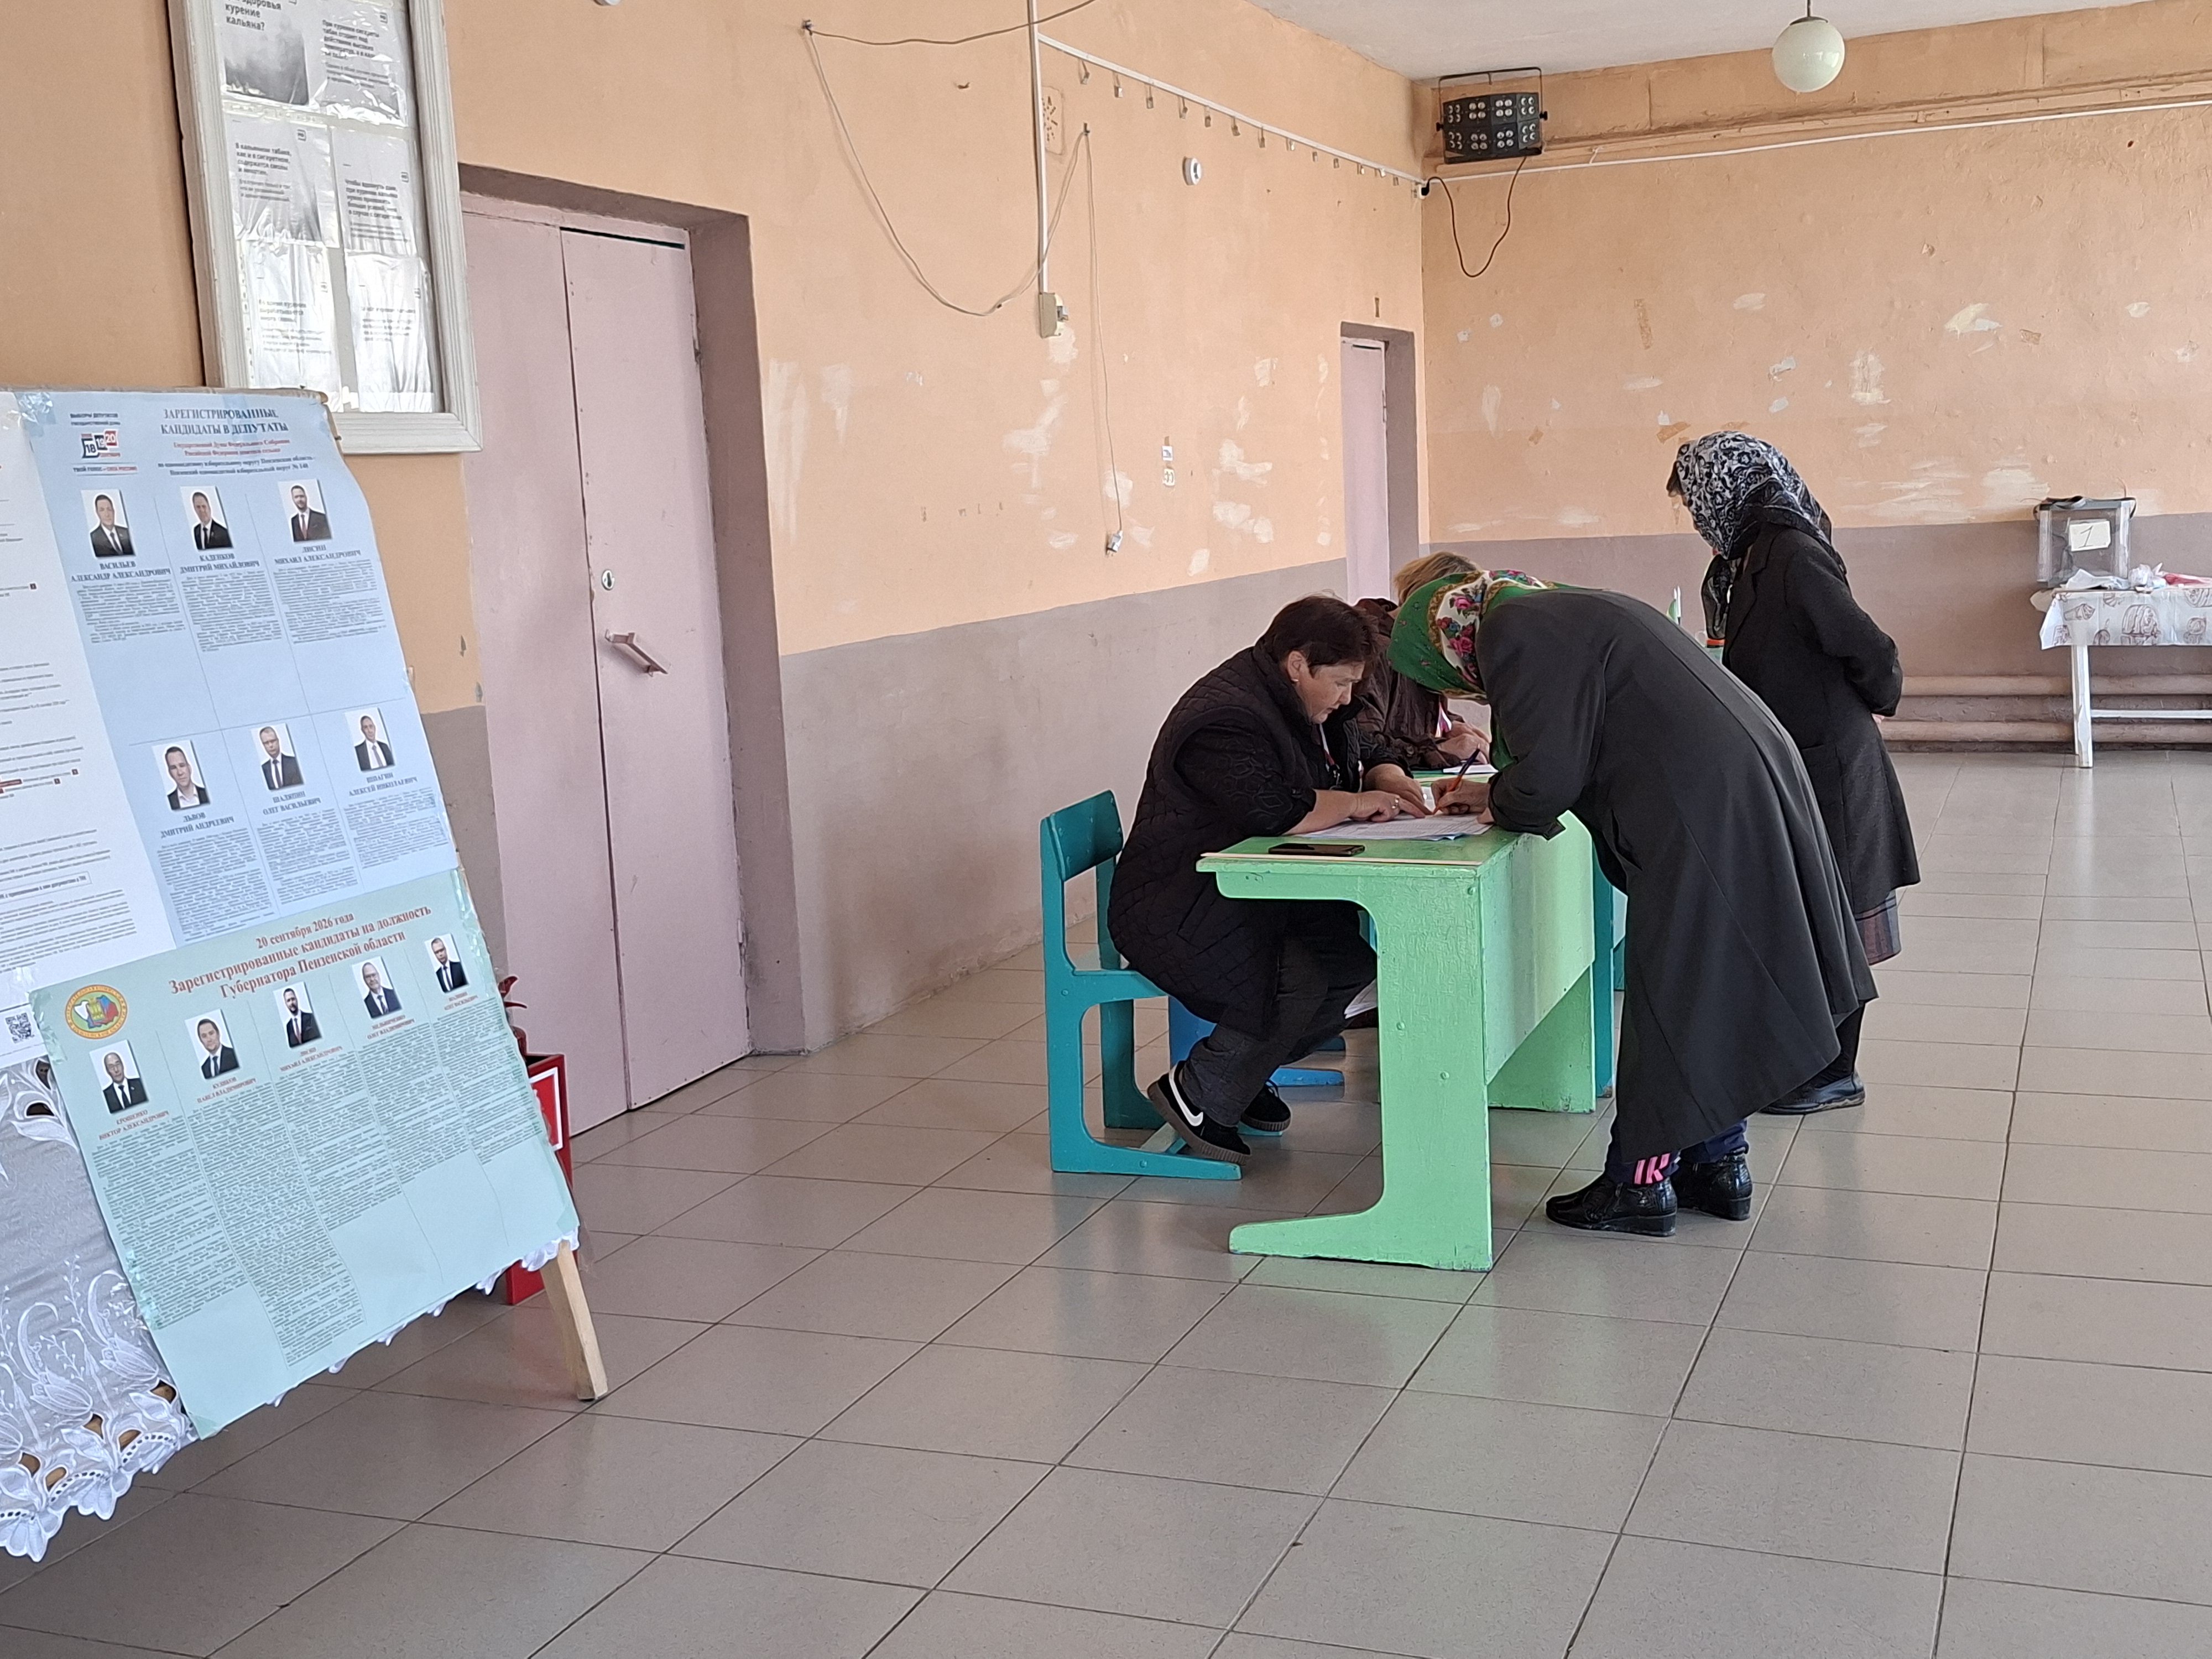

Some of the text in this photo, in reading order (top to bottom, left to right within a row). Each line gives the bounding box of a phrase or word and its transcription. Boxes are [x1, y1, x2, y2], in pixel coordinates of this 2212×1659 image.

[225, 3, 260, 18] курение
[226, 16, 265, 31] кальяна?
[163, 408, 279, 419] ЗАРЕГИСТРИРОВАННЫЕ
[161, 422, 289, 435] КАНДИДАТЫ В ДЕПУТАТЫ
[96, 437, 106, 447] 19
[105, 434, 116, 444] 20
[85, 444, 96, 453] 18
[2078, 525, 2094, 549] 1
[255, 912, 354, 949] 20 сентября 2026 года
[169, 906, 432, 994] Зарегистрированные кандидаты на должность
[220, 931, 406, 999] Губернатора Пензенской области
